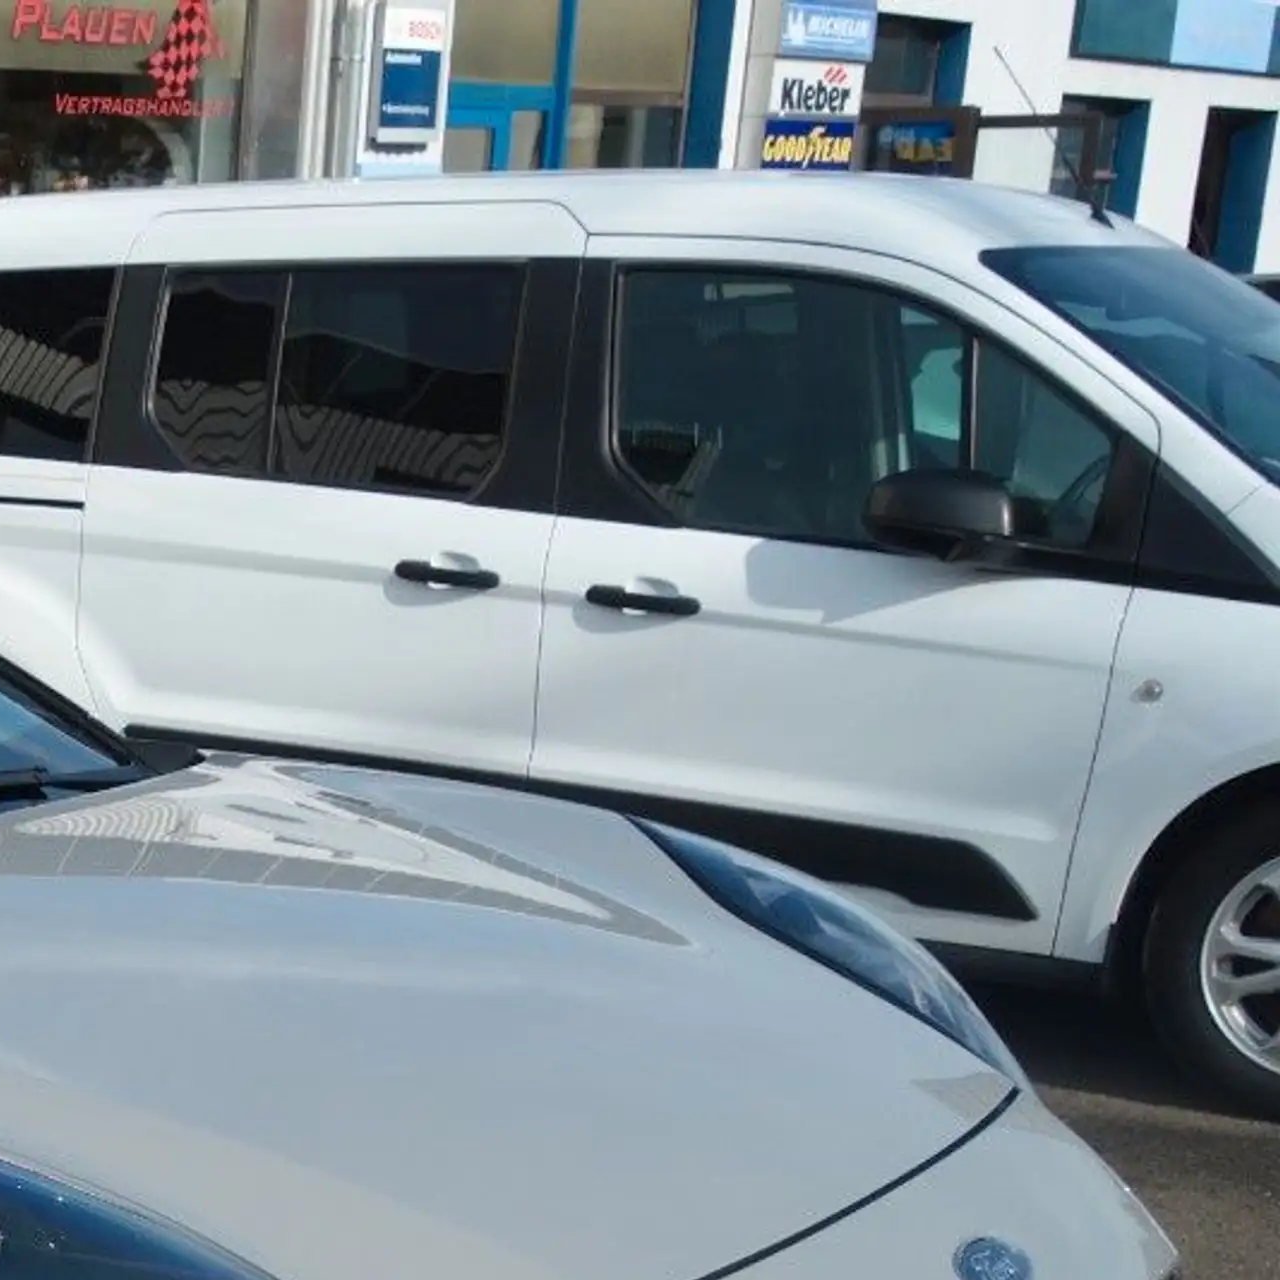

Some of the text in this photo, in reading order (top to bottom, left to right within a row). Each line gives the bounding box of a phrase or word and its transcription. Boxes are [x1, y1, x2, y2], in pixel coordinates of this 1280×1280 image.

[12, 0, 157, 44] PLAUEN
[780, 78, 852, 111] Kleber
[762, 126, 853, 168] GOODYEAR
